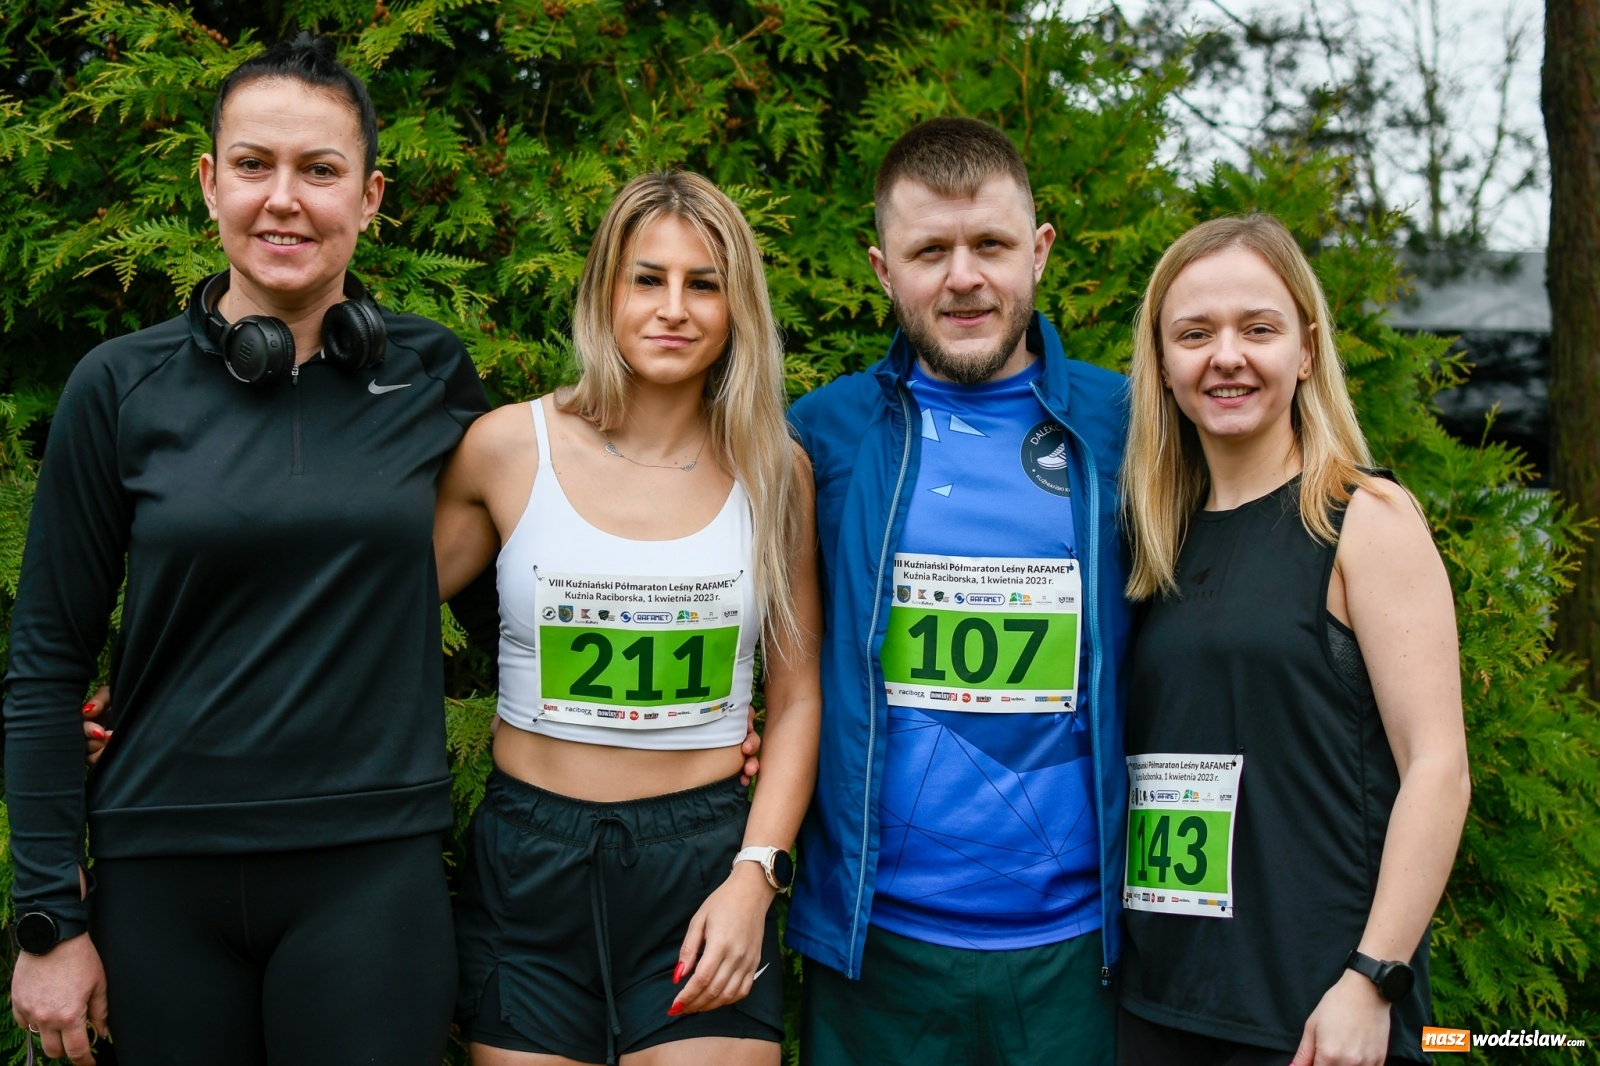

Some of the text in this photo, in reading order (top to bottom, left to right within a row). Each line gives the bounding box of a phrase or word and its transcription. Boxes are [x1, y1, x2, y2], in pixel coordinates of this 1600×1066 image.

[904, 560, 948, 570] Kuźniański
[950, 563, 1000, 572] Półmaraton
[1002, 564, 1026, 574] Leśny
[1028, 565, 1070, 574] RAFAMET
[904, 571, 930, 580] Kuźnia
[932, 573, 978, 584] Raciborska,
[980, 576, 985, 584] 1
[988, 576, 1024, 584] kwietnia
[1026, 576, 1046, 584] 2023
[548, 578, 564, 587] VIII
[566, 580, 613, 590] Kuźniański
[615, 582, 667, 591] Półmaraton
[669, 582, 694, 592] Leśny
[565, 591, 594, 600] Kuźnia
[596, 592, 646, 603] Raciborska,
[648, 594, 652, 602] 1
[654, 594, 692, 602] kwietnia
[694, 594, 714, 602] 2023
[908, 615, 1049, 684] 107
[570, 632, 710, 700] 211
[1180, 762, 1199, 770] Leśny
[1200, 762, 1233, 770] RAFAMET
[1169, 772, 1196, 781] kwietnia
[1198, 774, 1214, 782] 2023
[1138, 815, 1208, 886] 143
